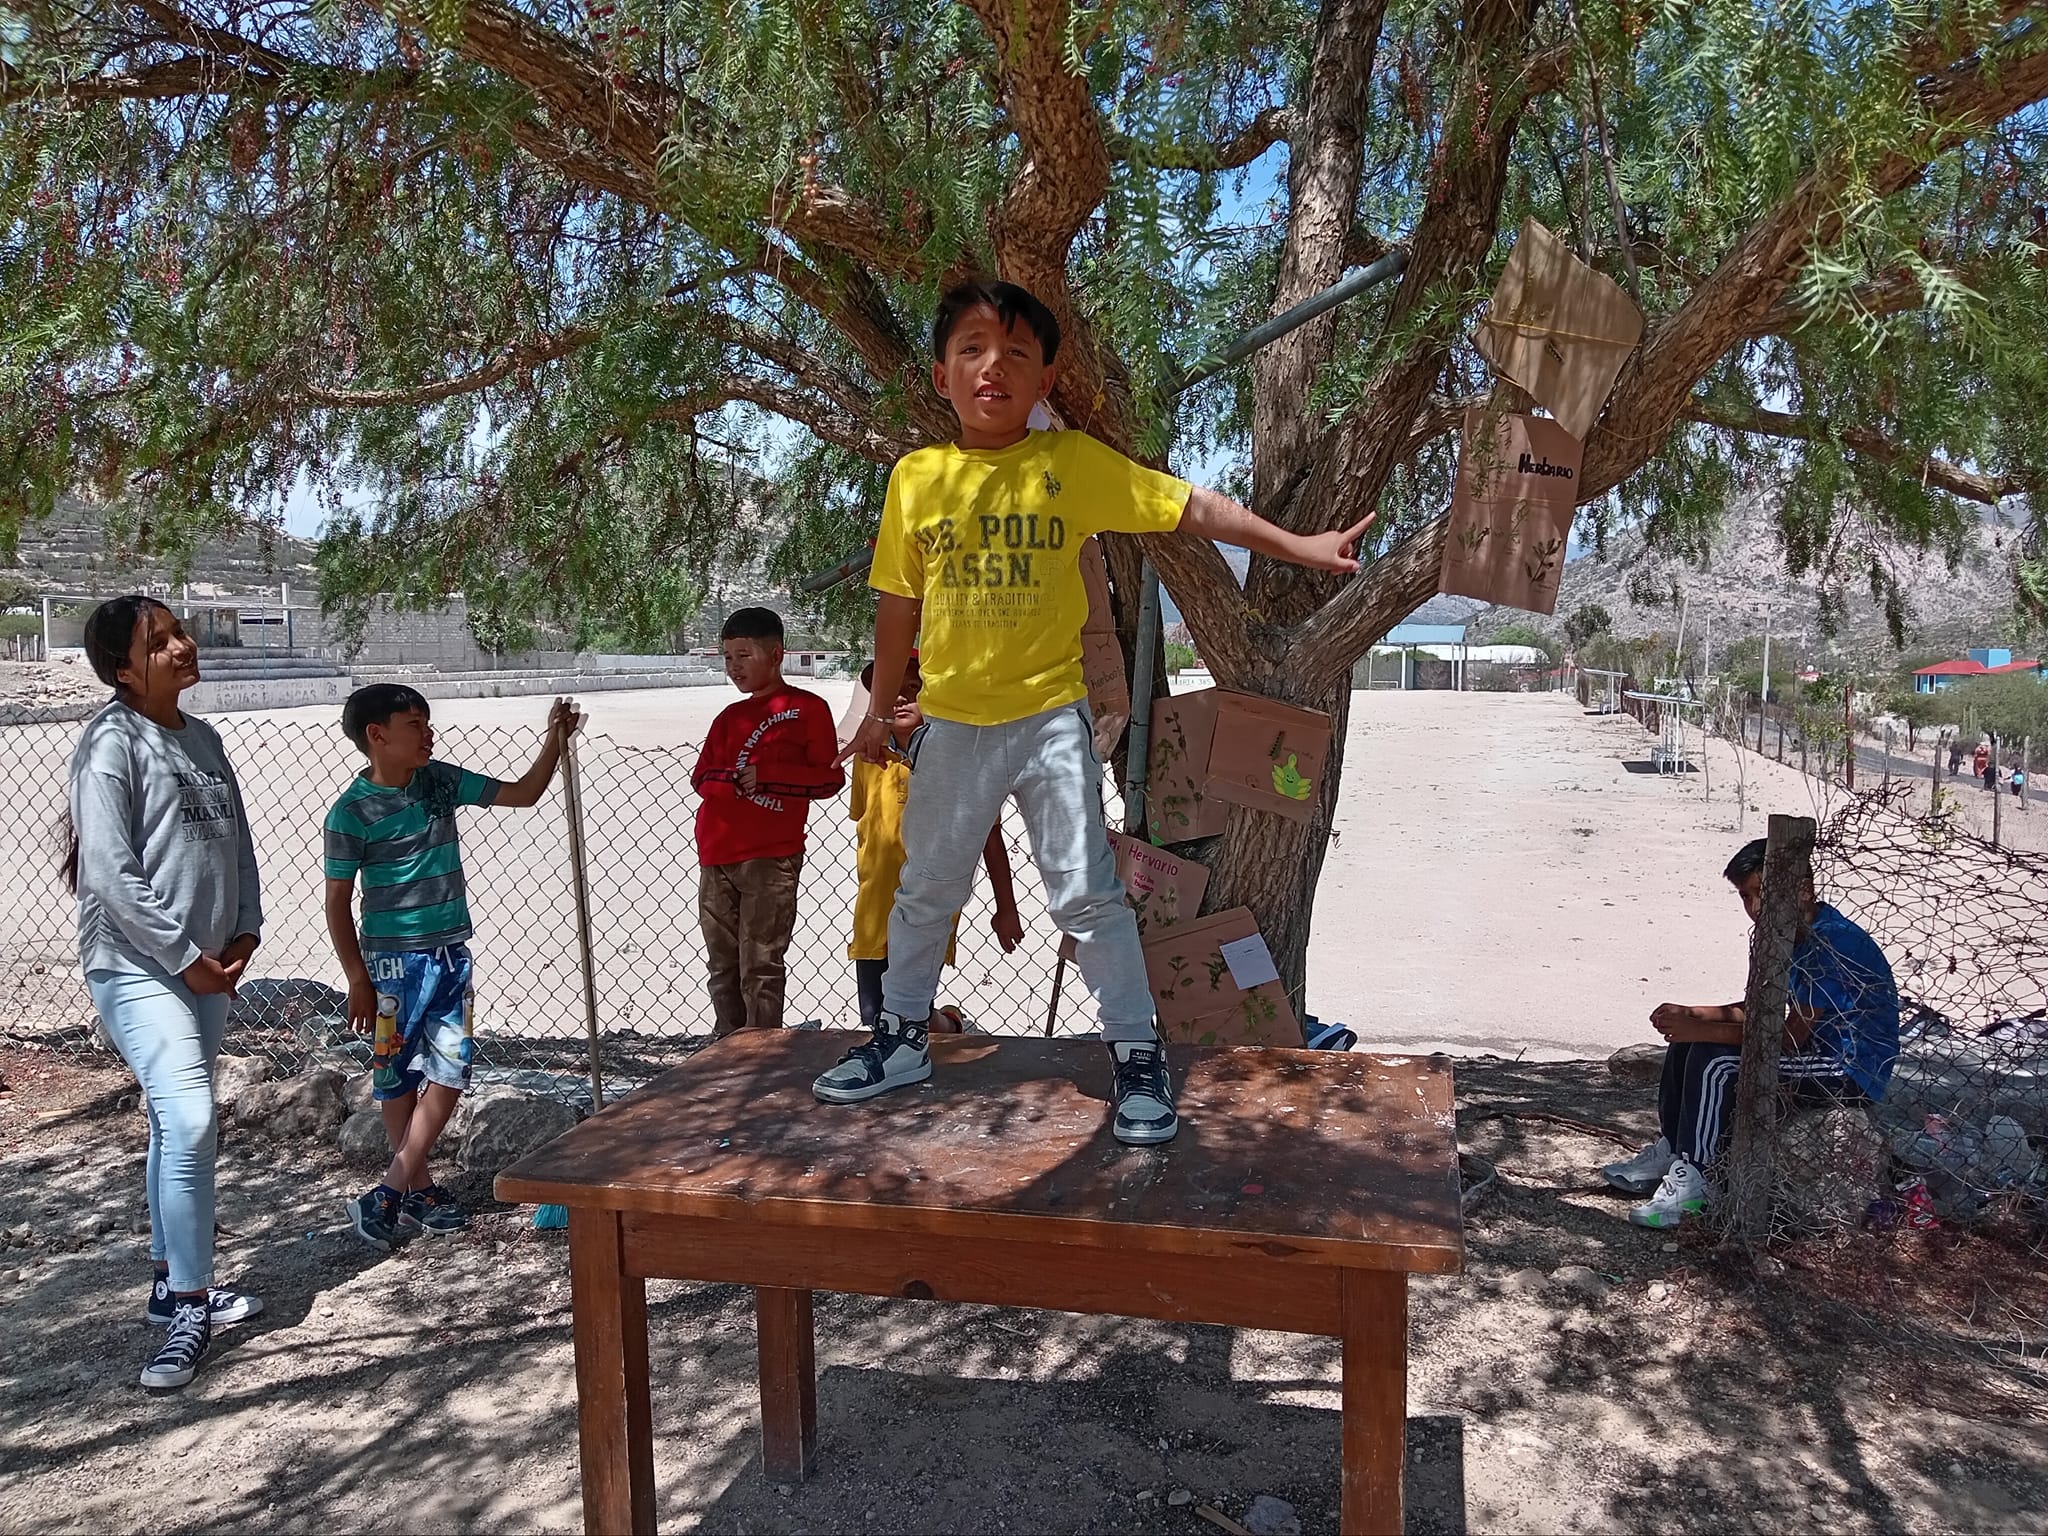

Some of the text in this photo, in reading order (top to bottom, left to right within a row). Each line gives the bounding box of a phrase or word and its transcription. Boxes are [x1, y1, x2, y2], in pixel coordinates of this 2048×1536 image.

[978, 513, 1065, 550] POLO
[942, 552, 1041, 588] ASSN.
[972, 592, 981, 607] &
[984, 592, 1040, 607] TRADITION
[744, 708, 800, 748] MACHINE
